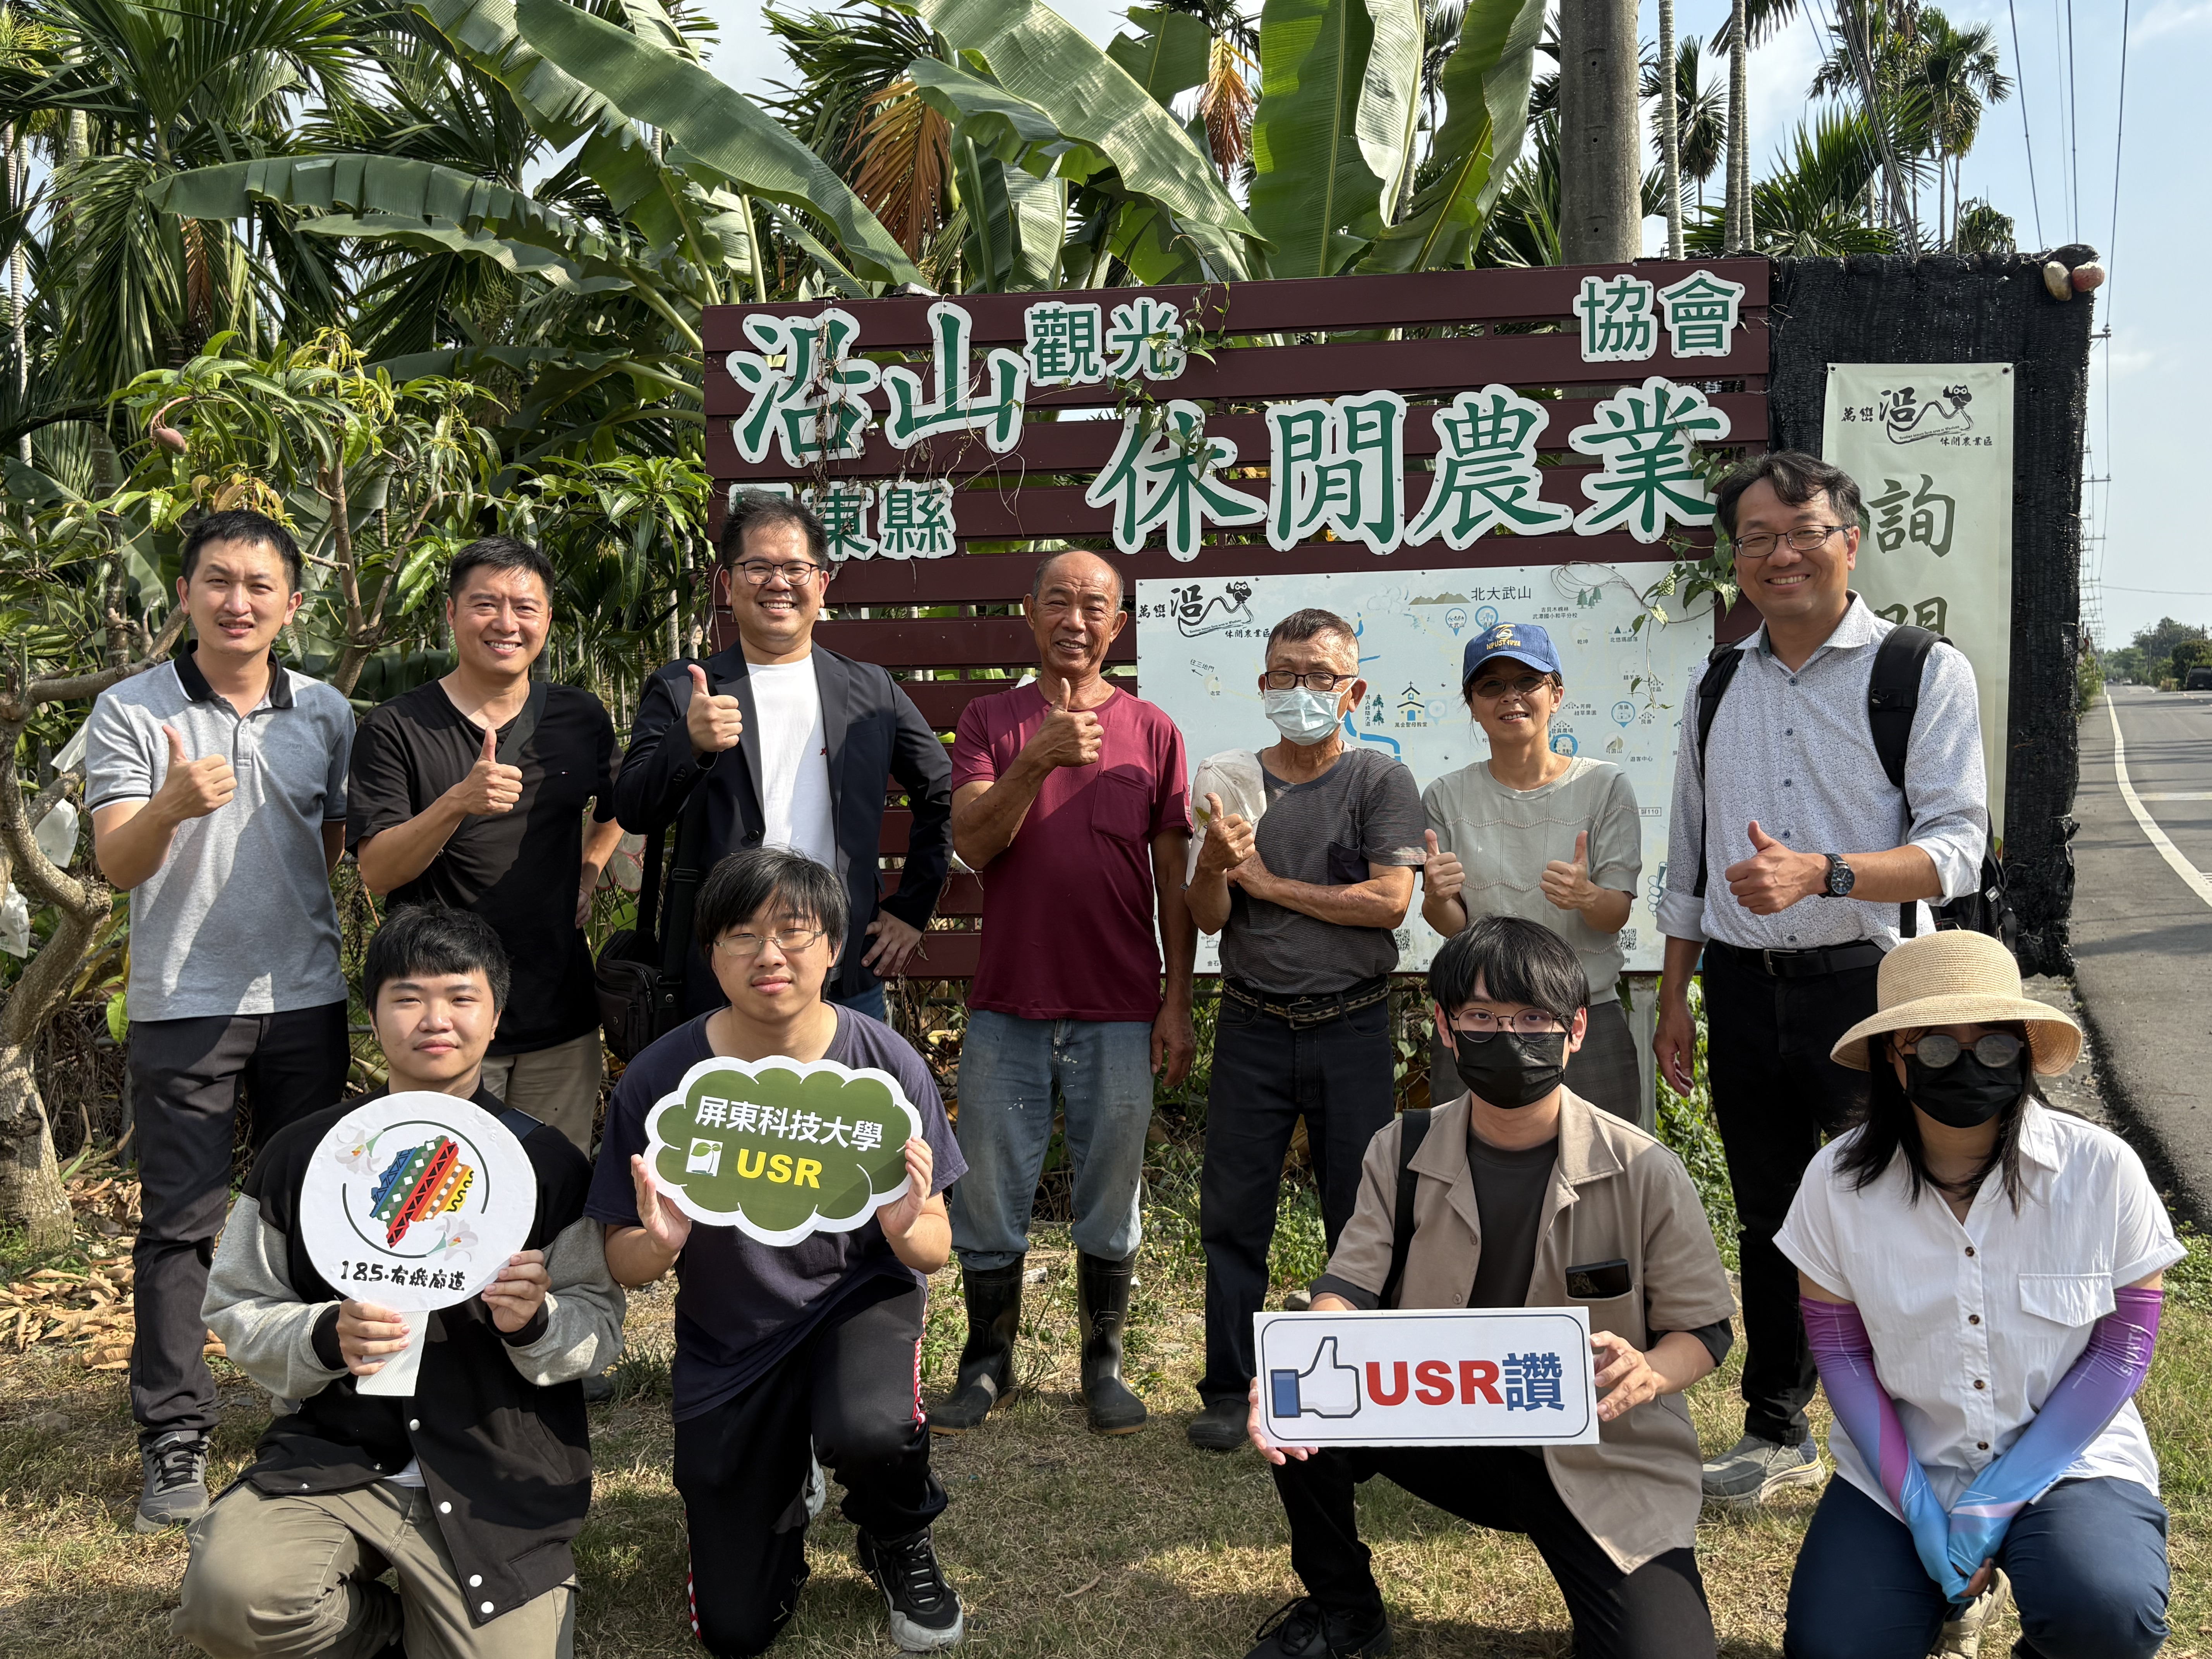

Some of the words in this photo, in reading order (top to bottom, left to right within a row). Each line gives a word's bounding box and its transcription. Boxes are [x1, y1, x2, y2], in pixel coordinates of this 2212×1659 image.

[1028, 304, 1183, 381] 觀光
[1578, 276, 1739, 357] 協會
[730, 308, 1024, 463] 沿山
[735, 487, 953, 556] 東縣
[1471, 586, 1531, 601] 北大武山
[1486, 639, 1506, 650] NPUST
[695, 1095, 883, 1151] 屏東科技大學
[737, 1149, 823, 1189] USR
[1366, 1352, 1565, 1412] USR讚
